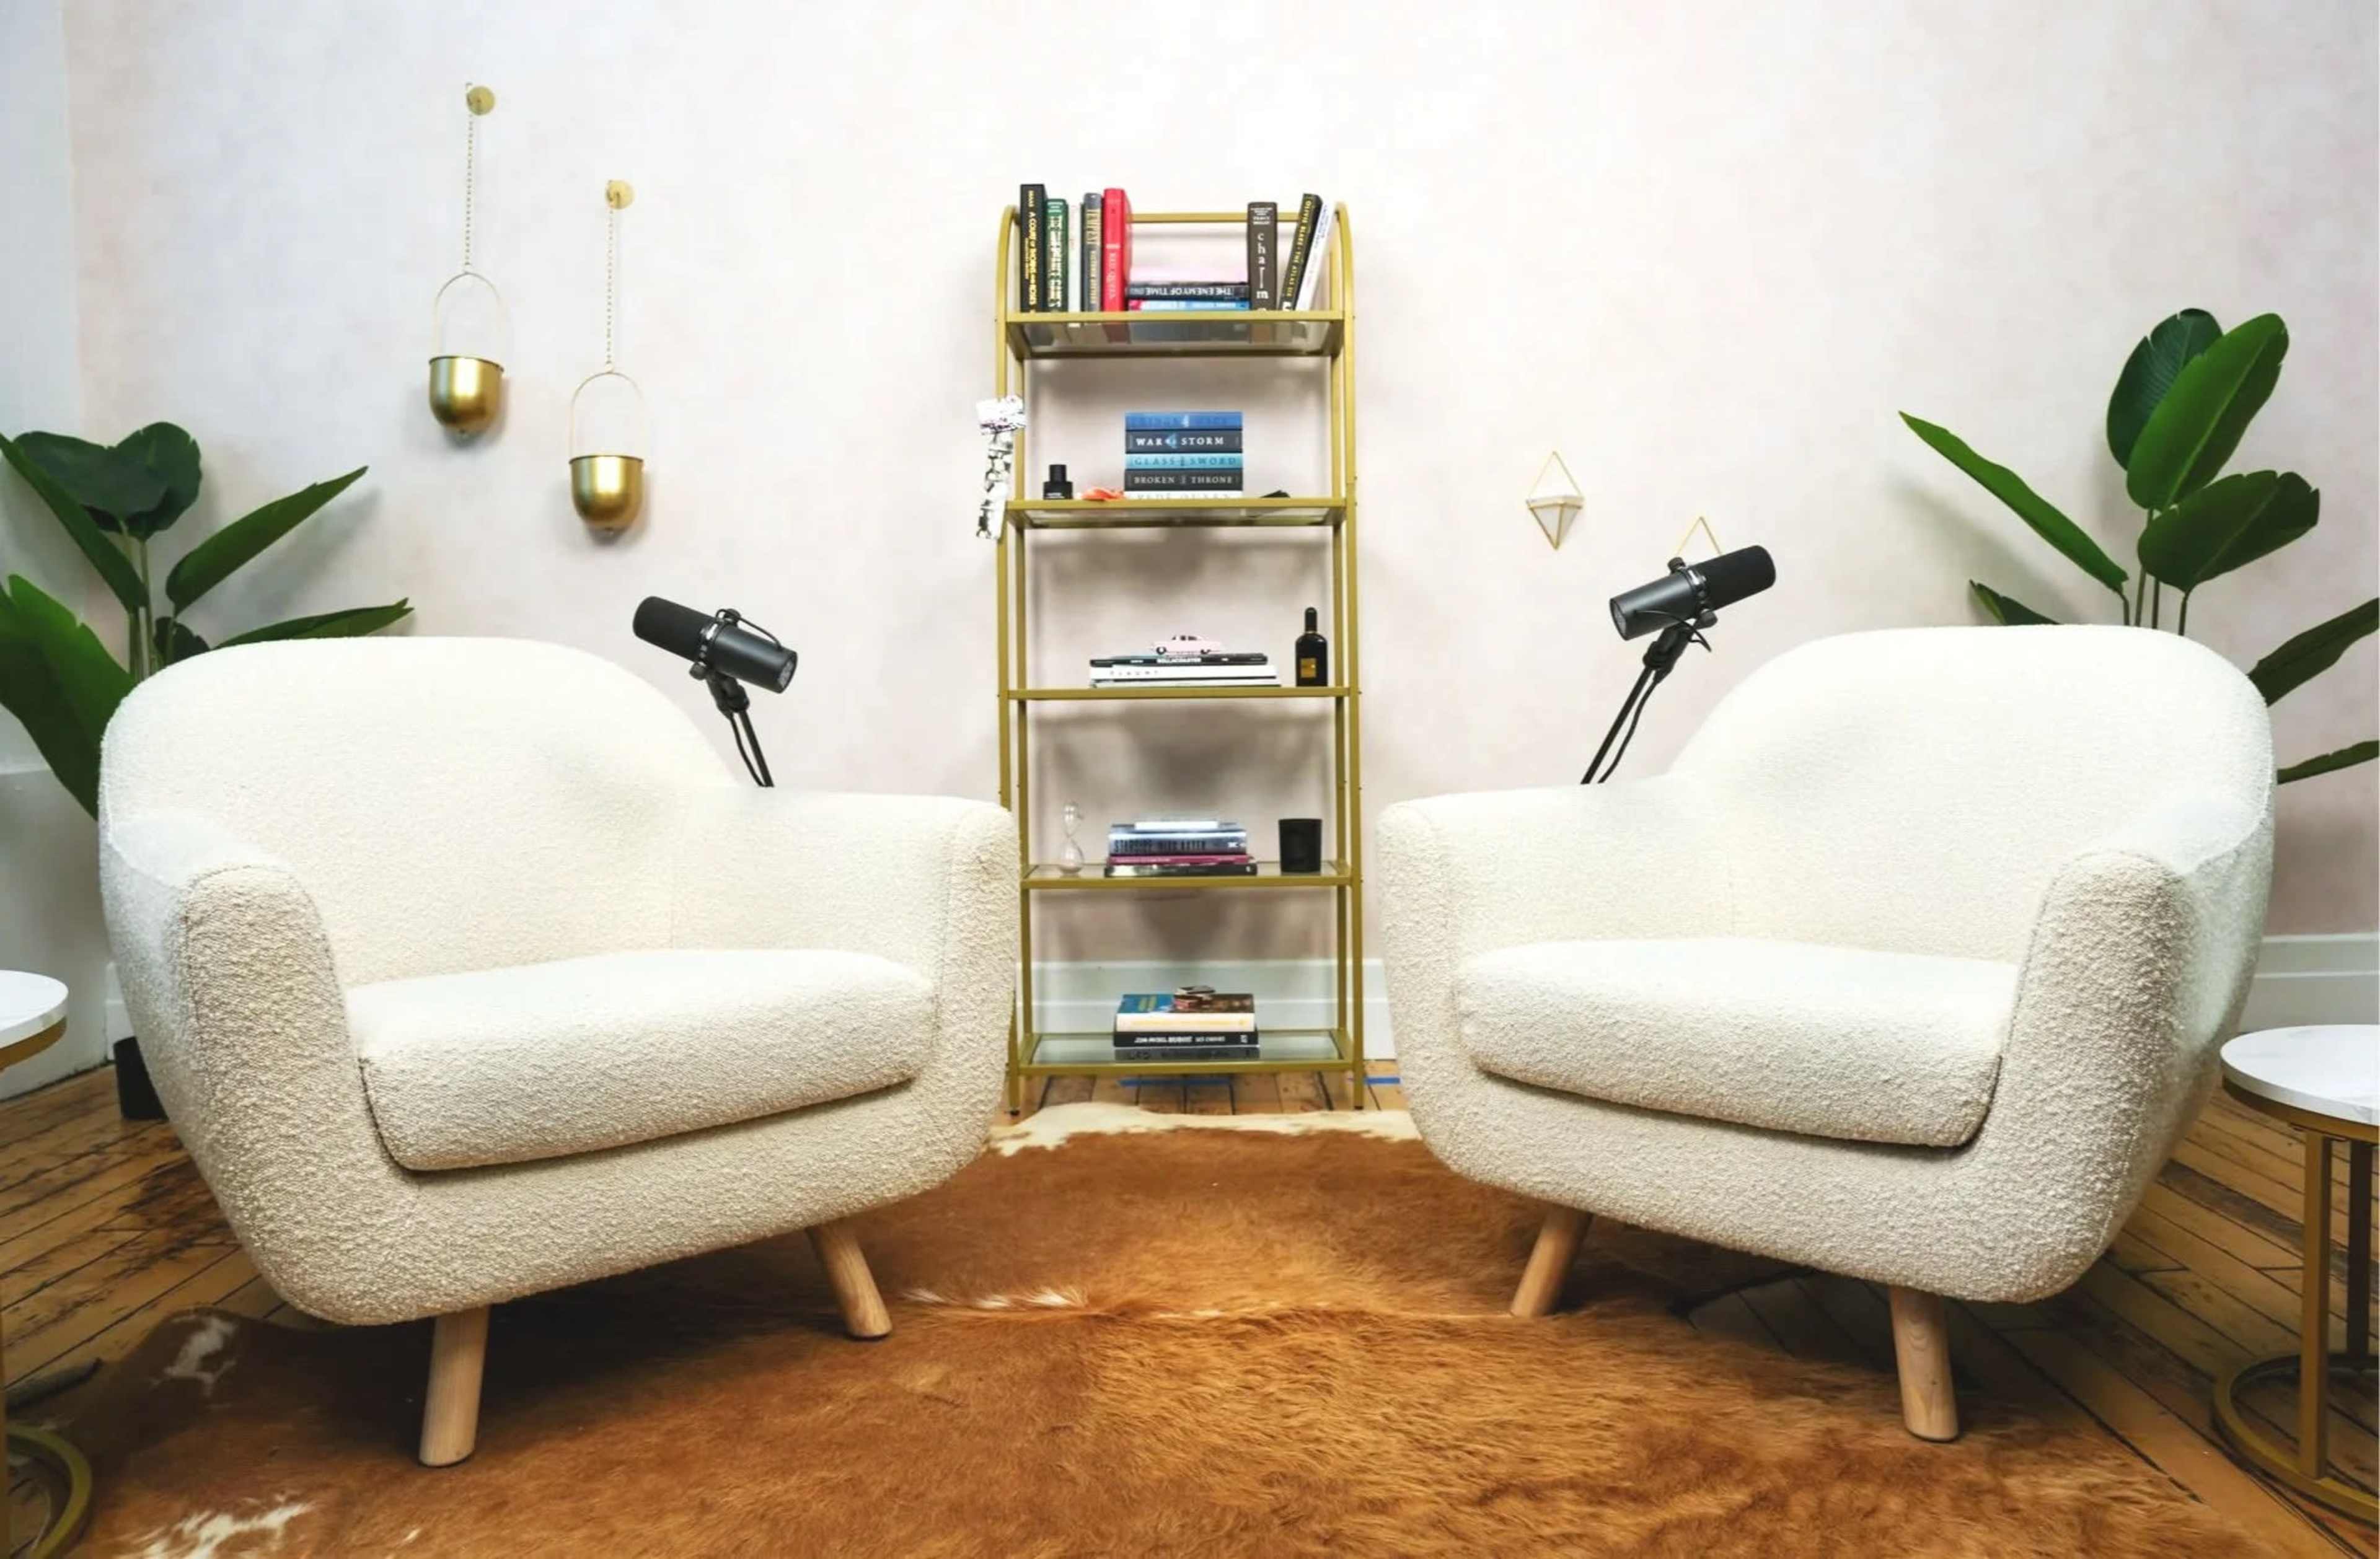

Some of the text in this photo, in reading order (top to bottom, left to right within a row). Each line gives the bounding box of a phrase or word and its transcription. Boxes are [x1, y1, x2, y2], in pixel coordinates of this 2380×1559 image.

[1029, 218, 1037, 240] COURT
[1029, 284, 1037, 305] ROSES
[1135, 436, 1225, 446] WAR STORM
[1134, 457, 1236, 466] GLASS SWORD
[1134, 475, 1232, 485] BROKEN THRONE
